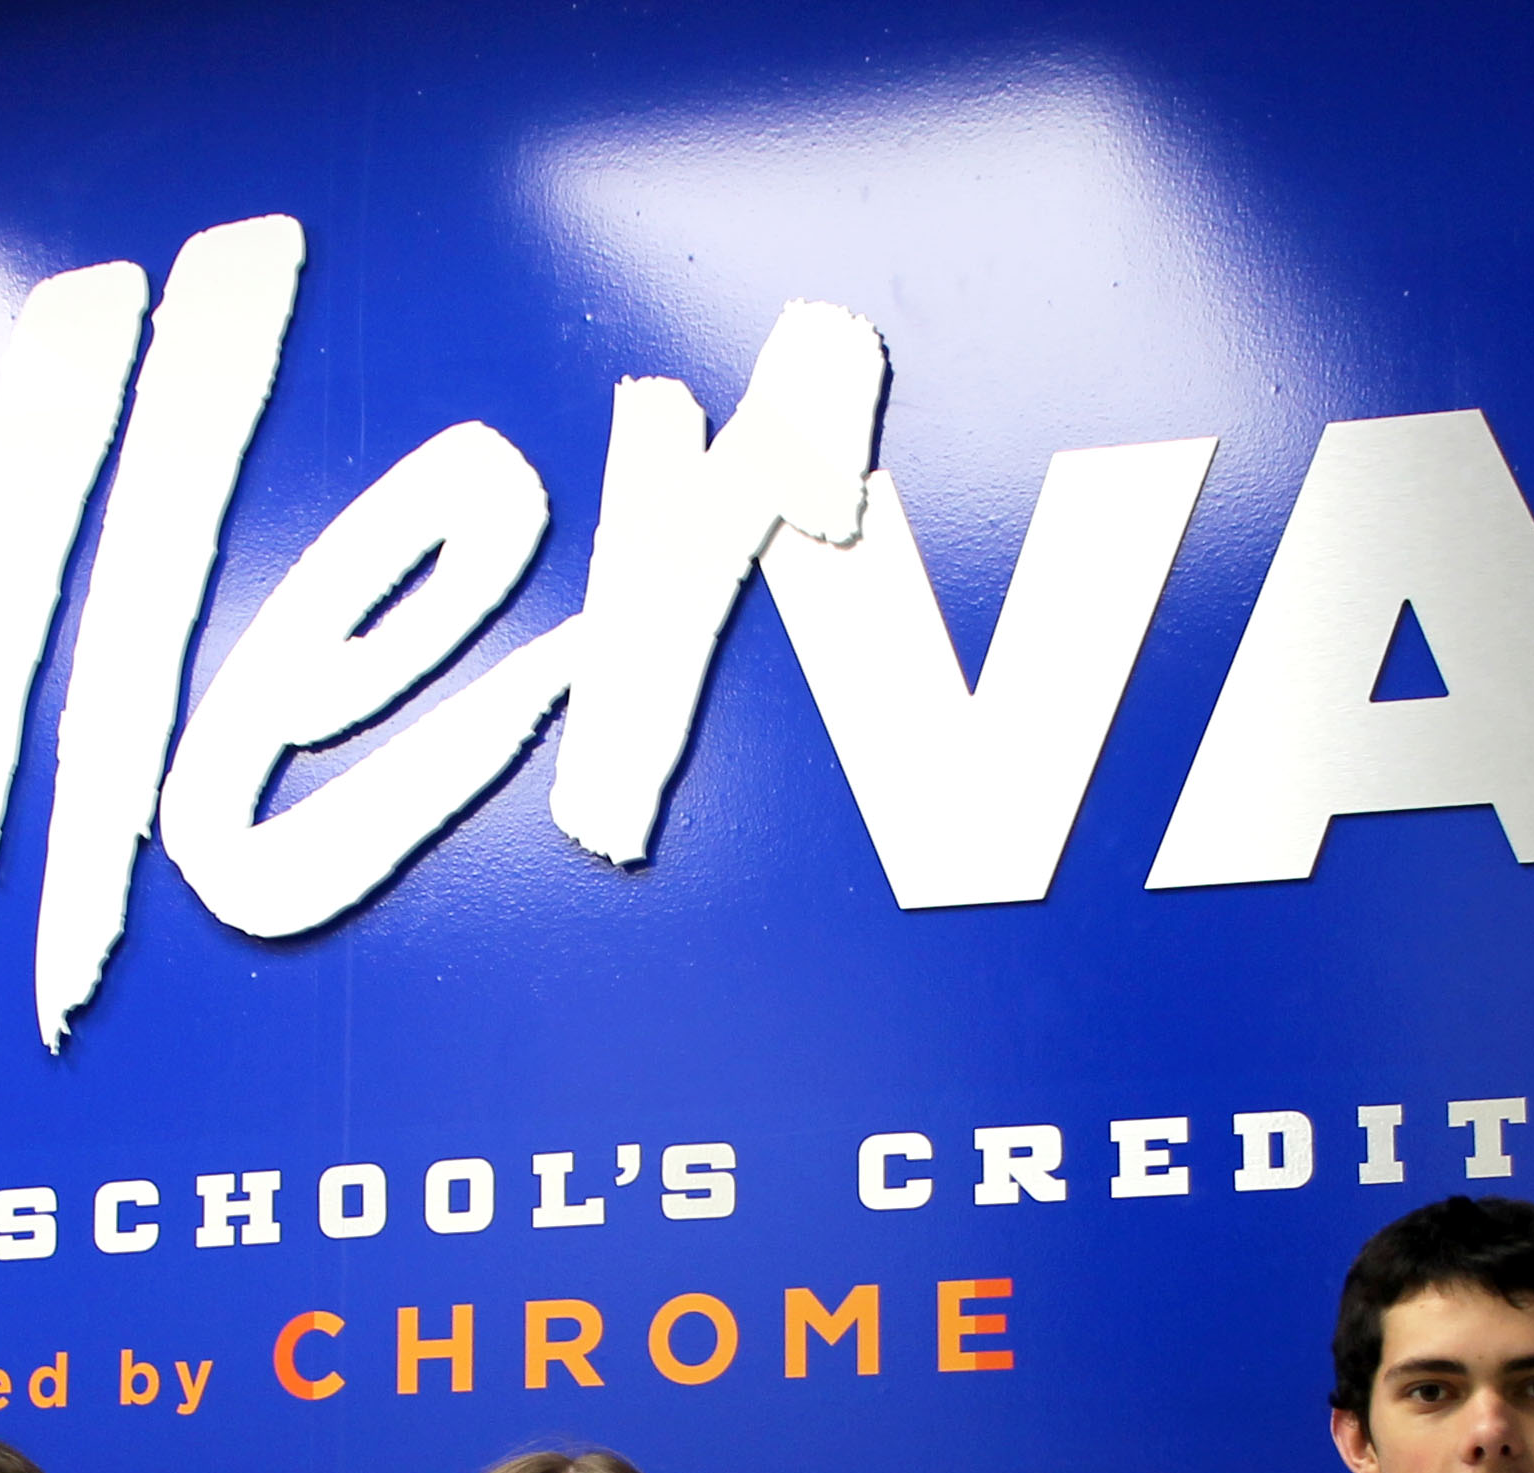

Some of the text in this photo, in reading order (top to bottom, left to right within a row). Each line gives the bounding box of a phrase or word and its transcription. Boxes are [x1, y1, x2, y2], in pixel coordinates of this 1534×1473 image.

[856, 1096, 1529, 1210] CREDIT
[119, 1349, 214, 1414] by
[272, 1277, 1015, 1400] CHROME
